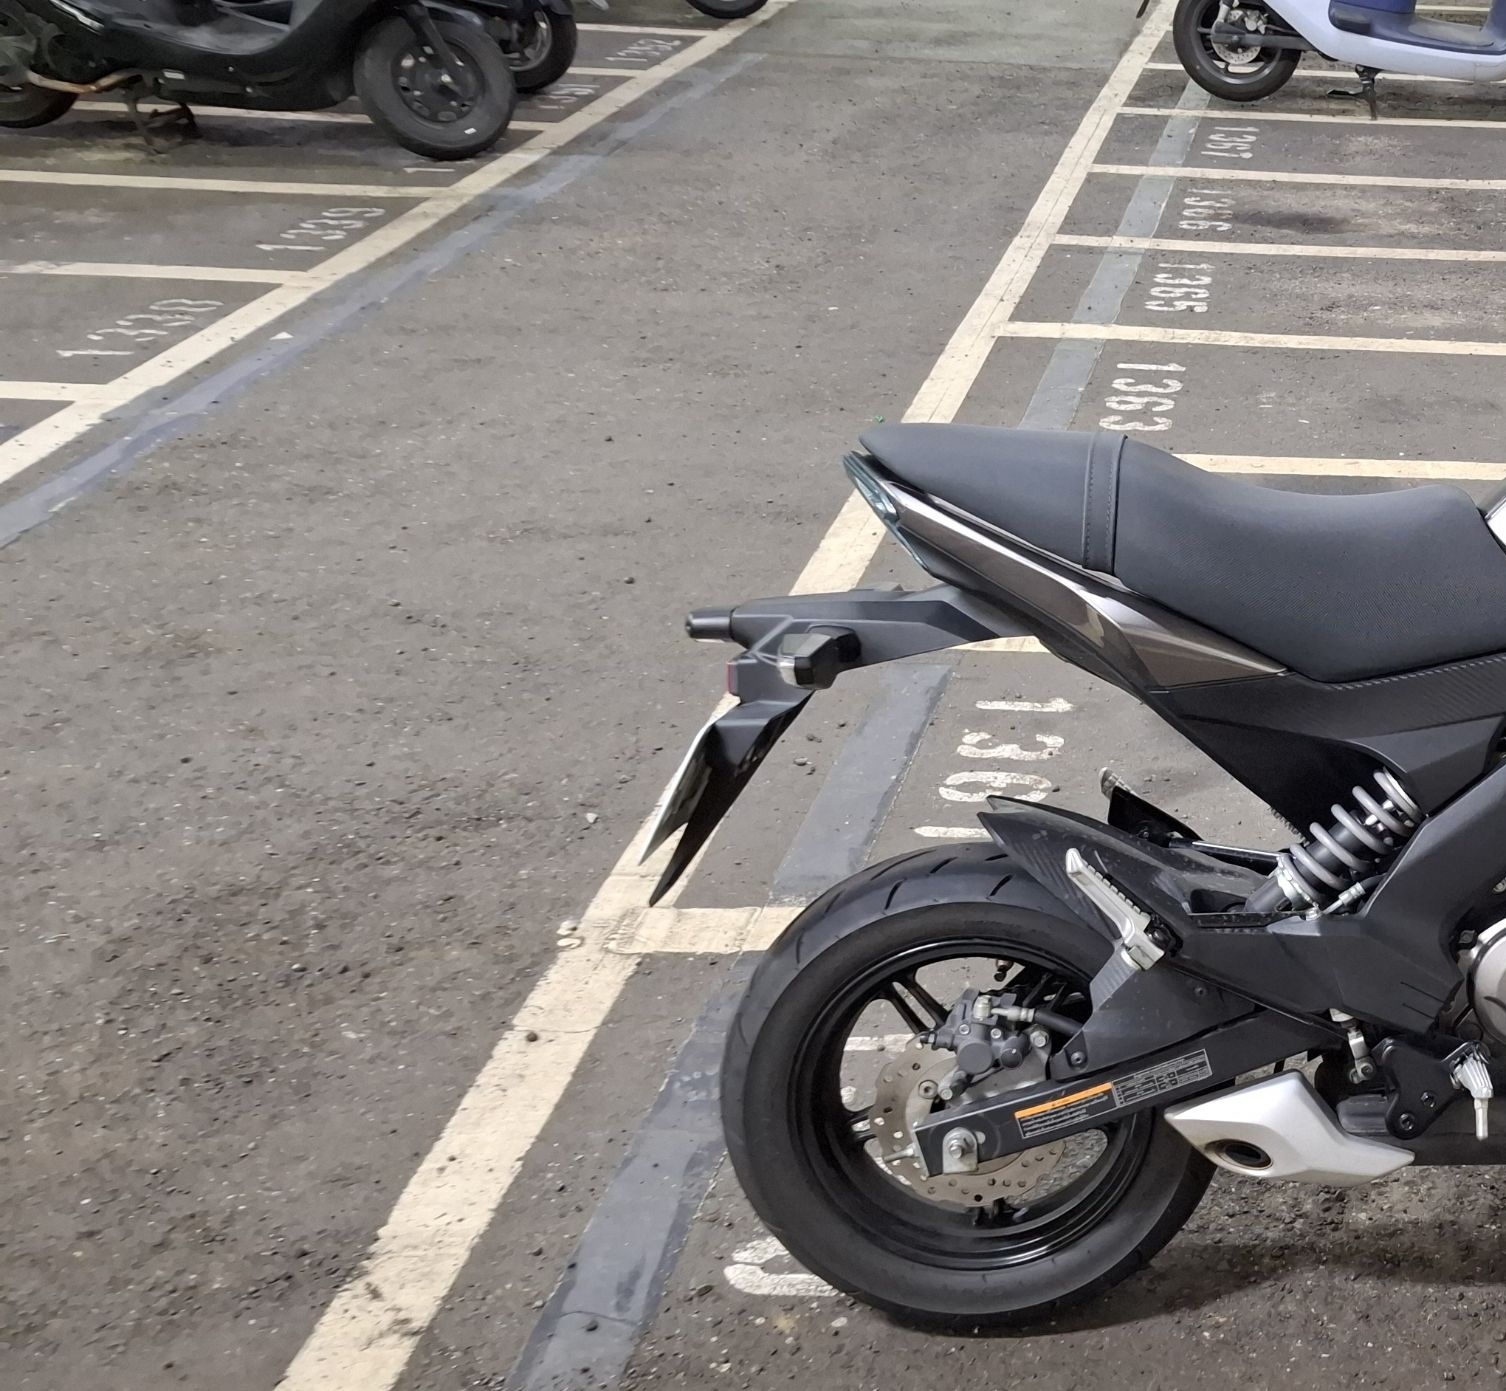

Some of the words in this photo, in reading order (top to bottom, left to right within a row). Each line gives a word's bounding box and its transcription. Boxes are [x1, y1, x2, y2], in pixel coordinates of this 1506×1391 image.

[256, 207, 386, 251] 1339
[1179, 188, 1233, 232] 1366
[1144, 262, 1215, 313] 1365
[1099, 362, 1187, 432] 1363
